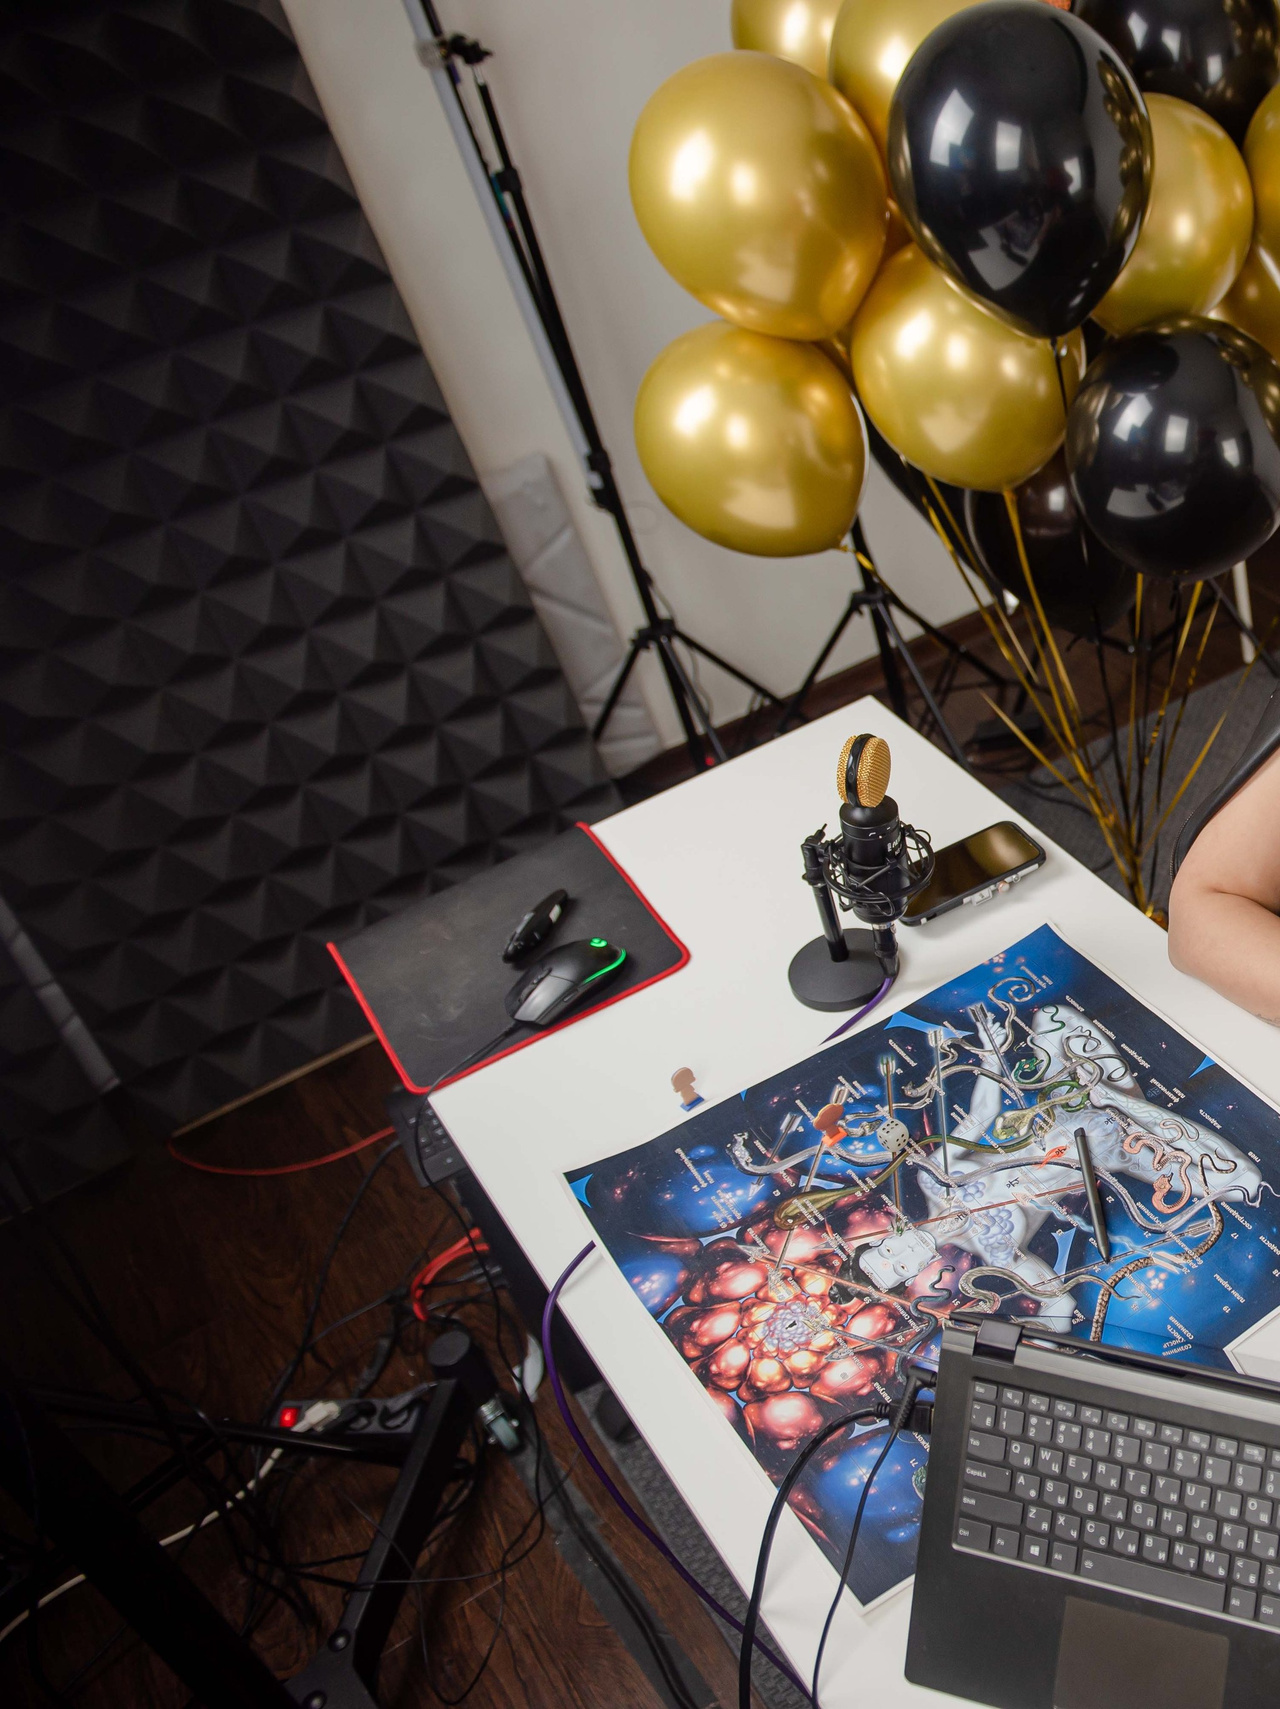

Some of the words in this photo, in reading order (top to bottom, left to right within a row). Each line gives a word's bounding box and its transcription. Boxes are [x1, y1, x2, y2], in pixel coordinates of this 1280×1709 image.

[1062, 994, 1084, 1012] алчность
[1091, 1019, 1116, 1039] тщеславие
[1119, 1043, 1151, 1068] заблуждение
[1148, 1077, 1180, 1103] физический
[1171, 1086, 1186, 1098] план
[1196, 1108, 1222, 1129] жадность
[1246, 1151, 1261, 1162] гнев
[1134, 1201, 1164, 1228] искупление
[1219, 1201, 1252, 1229] сострадание
[1212, 1273, 1232, 1290] кармы
[1230, 1289, 1245, 1303] план
[1168, 1315, 1194, 1339] сознания
